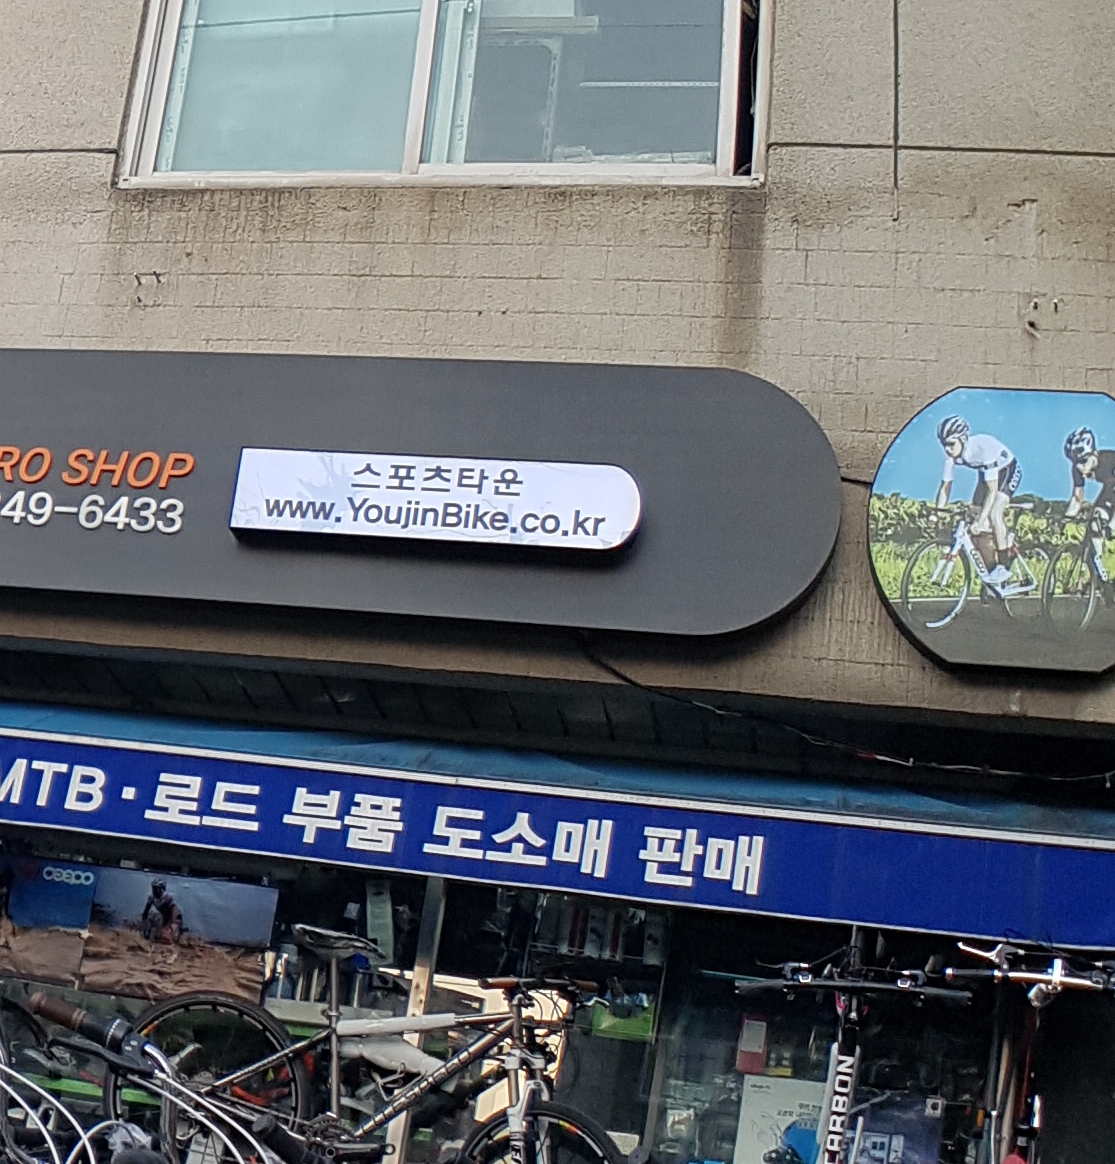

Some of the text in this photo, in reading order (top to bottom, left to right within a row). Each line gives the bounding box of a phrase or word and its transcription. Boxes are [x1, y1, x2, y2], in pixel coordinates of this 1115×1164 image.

[61, 448, 196, 490] SHOP
[350, 462, 524, 498] 스포츠타운
[264, 496, 606, 538] www.YoujinBike.co.kr
[282, 786, 404, 853] 부품
[422, 805, 614, 879] 도소매
[638, 826, 766, 896] 판매
